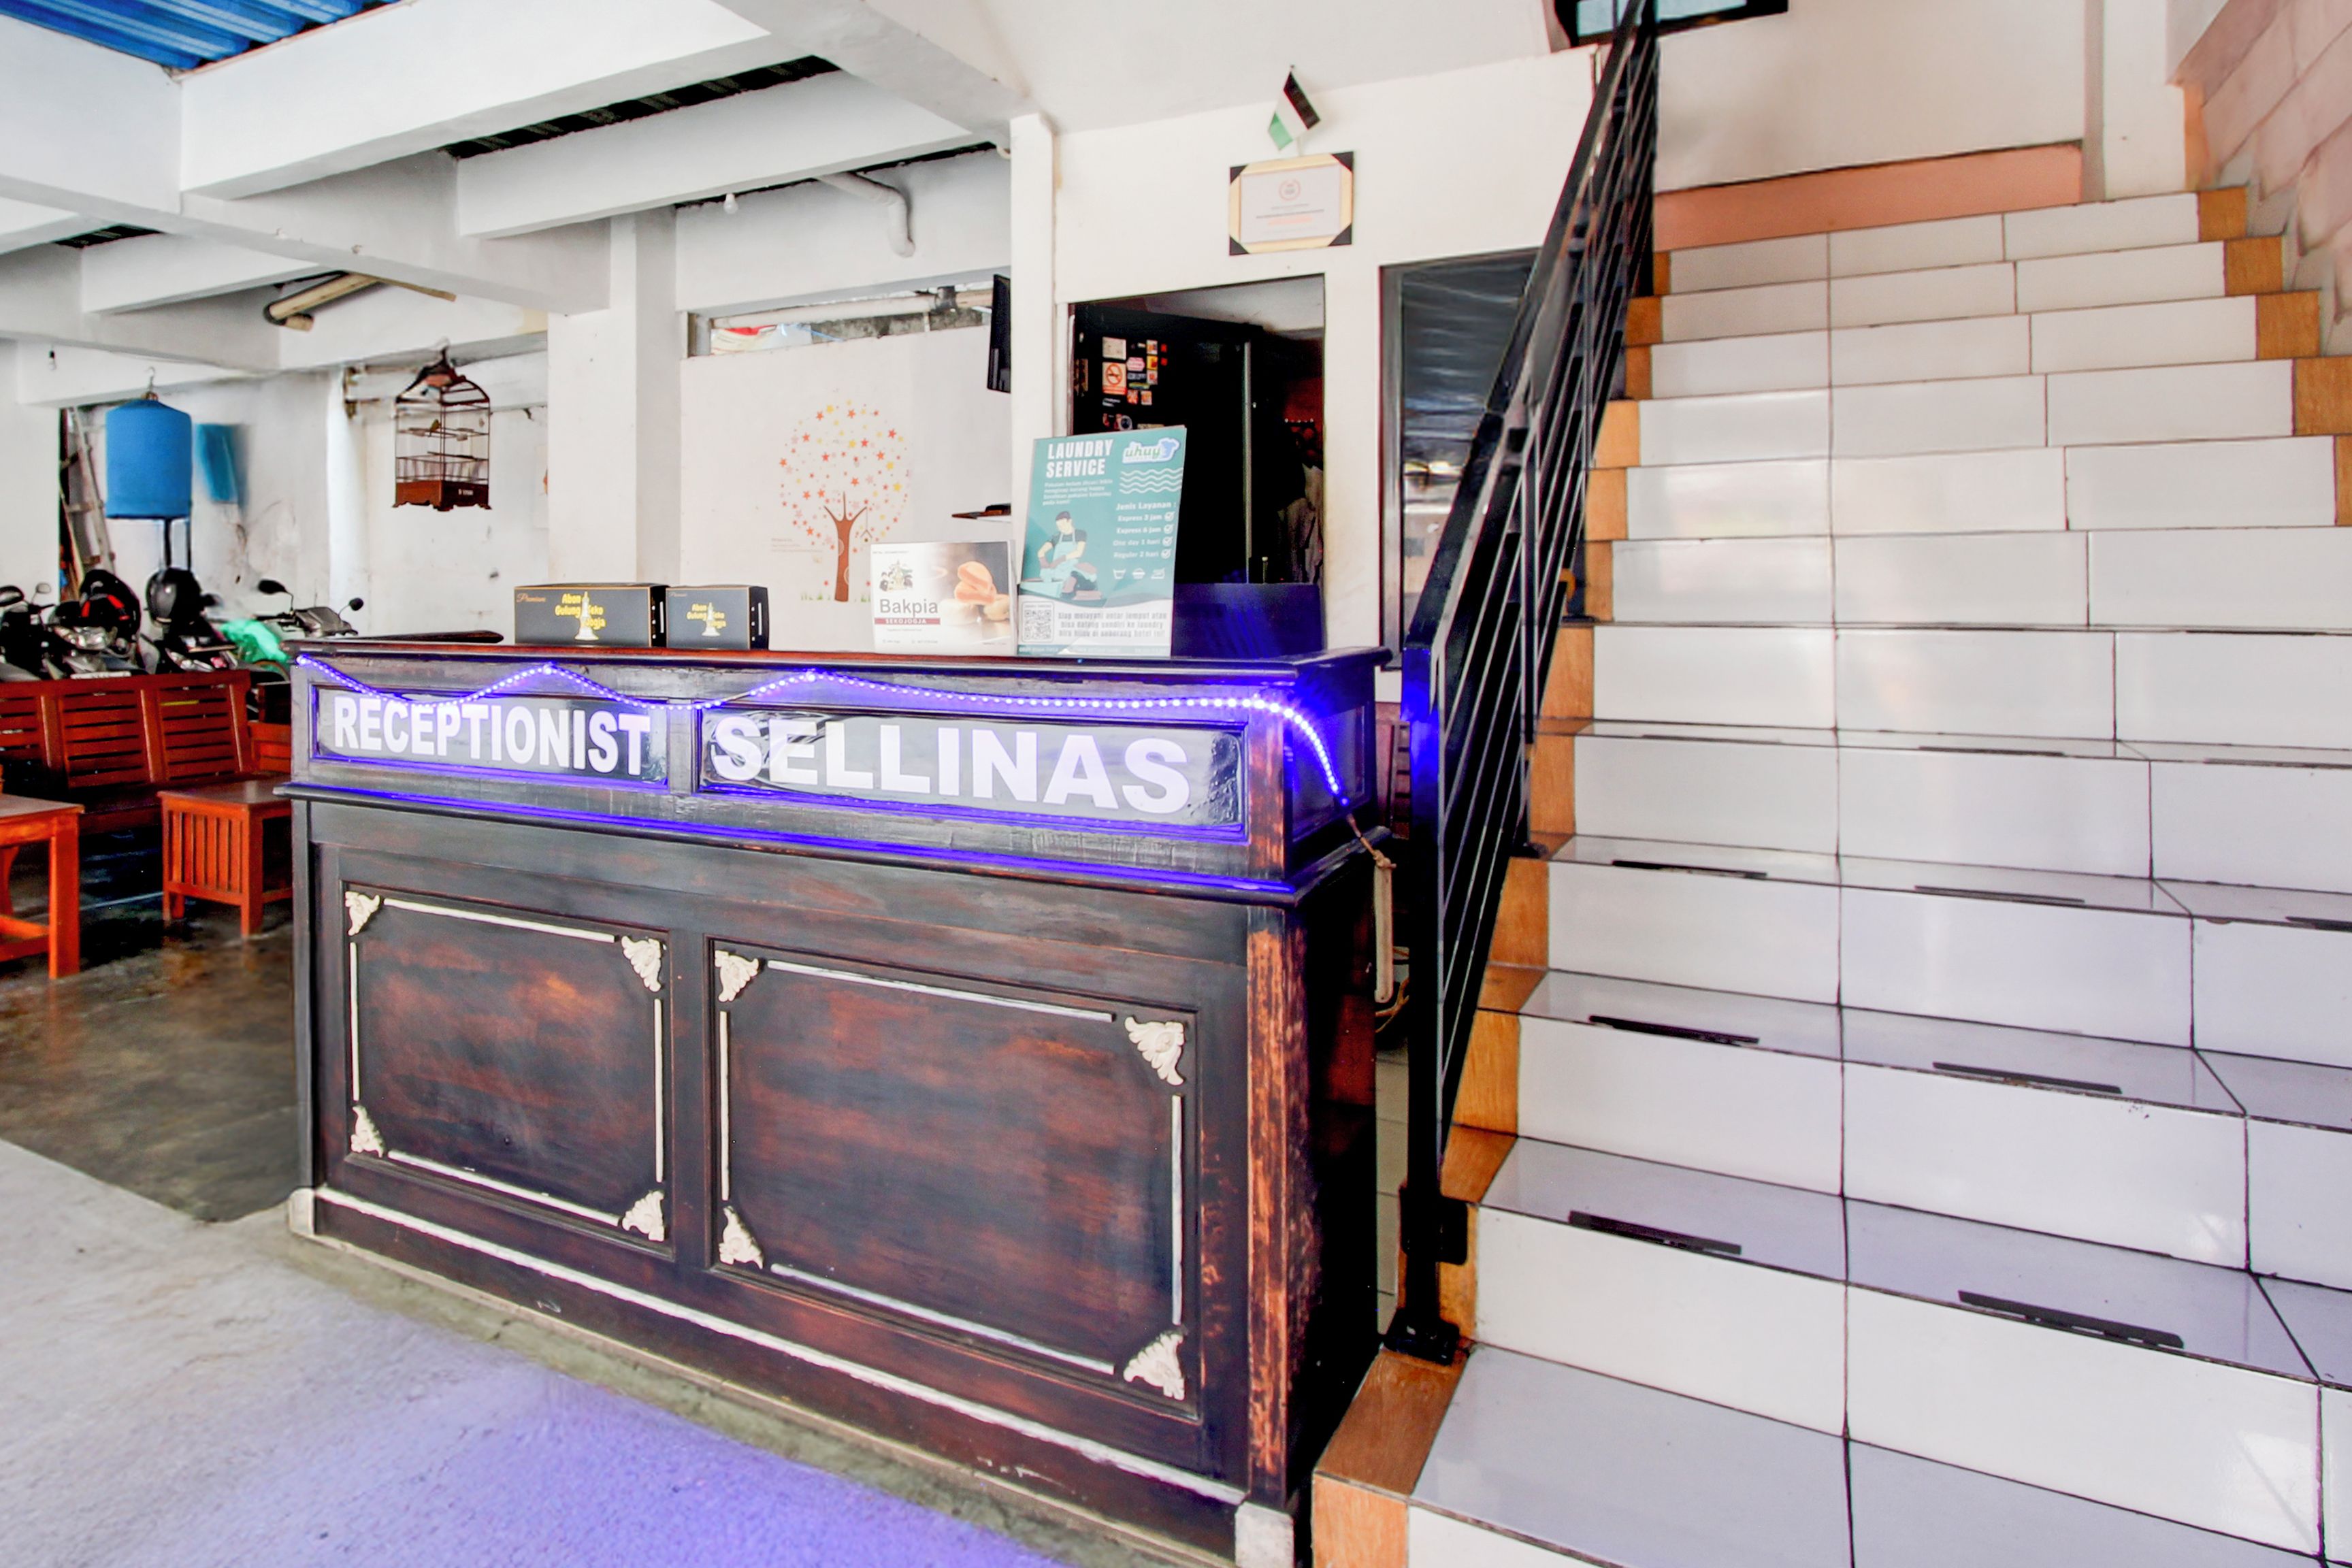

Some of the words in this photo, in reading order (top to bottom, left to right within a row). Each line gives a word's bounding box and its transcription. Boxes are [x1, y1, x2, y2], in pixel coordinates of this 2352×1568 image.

[1047, 439, 1114, 459] LAUNDRY
[1125, 445, 1160, 460] uhuy
[1045, 458, 1106, 478] SERVICE
[1139, 502, 1171, 510] Layanan
[561, 593, 581, 604] Abon
[879, 598, 938, 617] Bakpia
[333, 696, 651, 777] RECEPTIONIST
[710, 715, 1192, 815] SELLINAS
